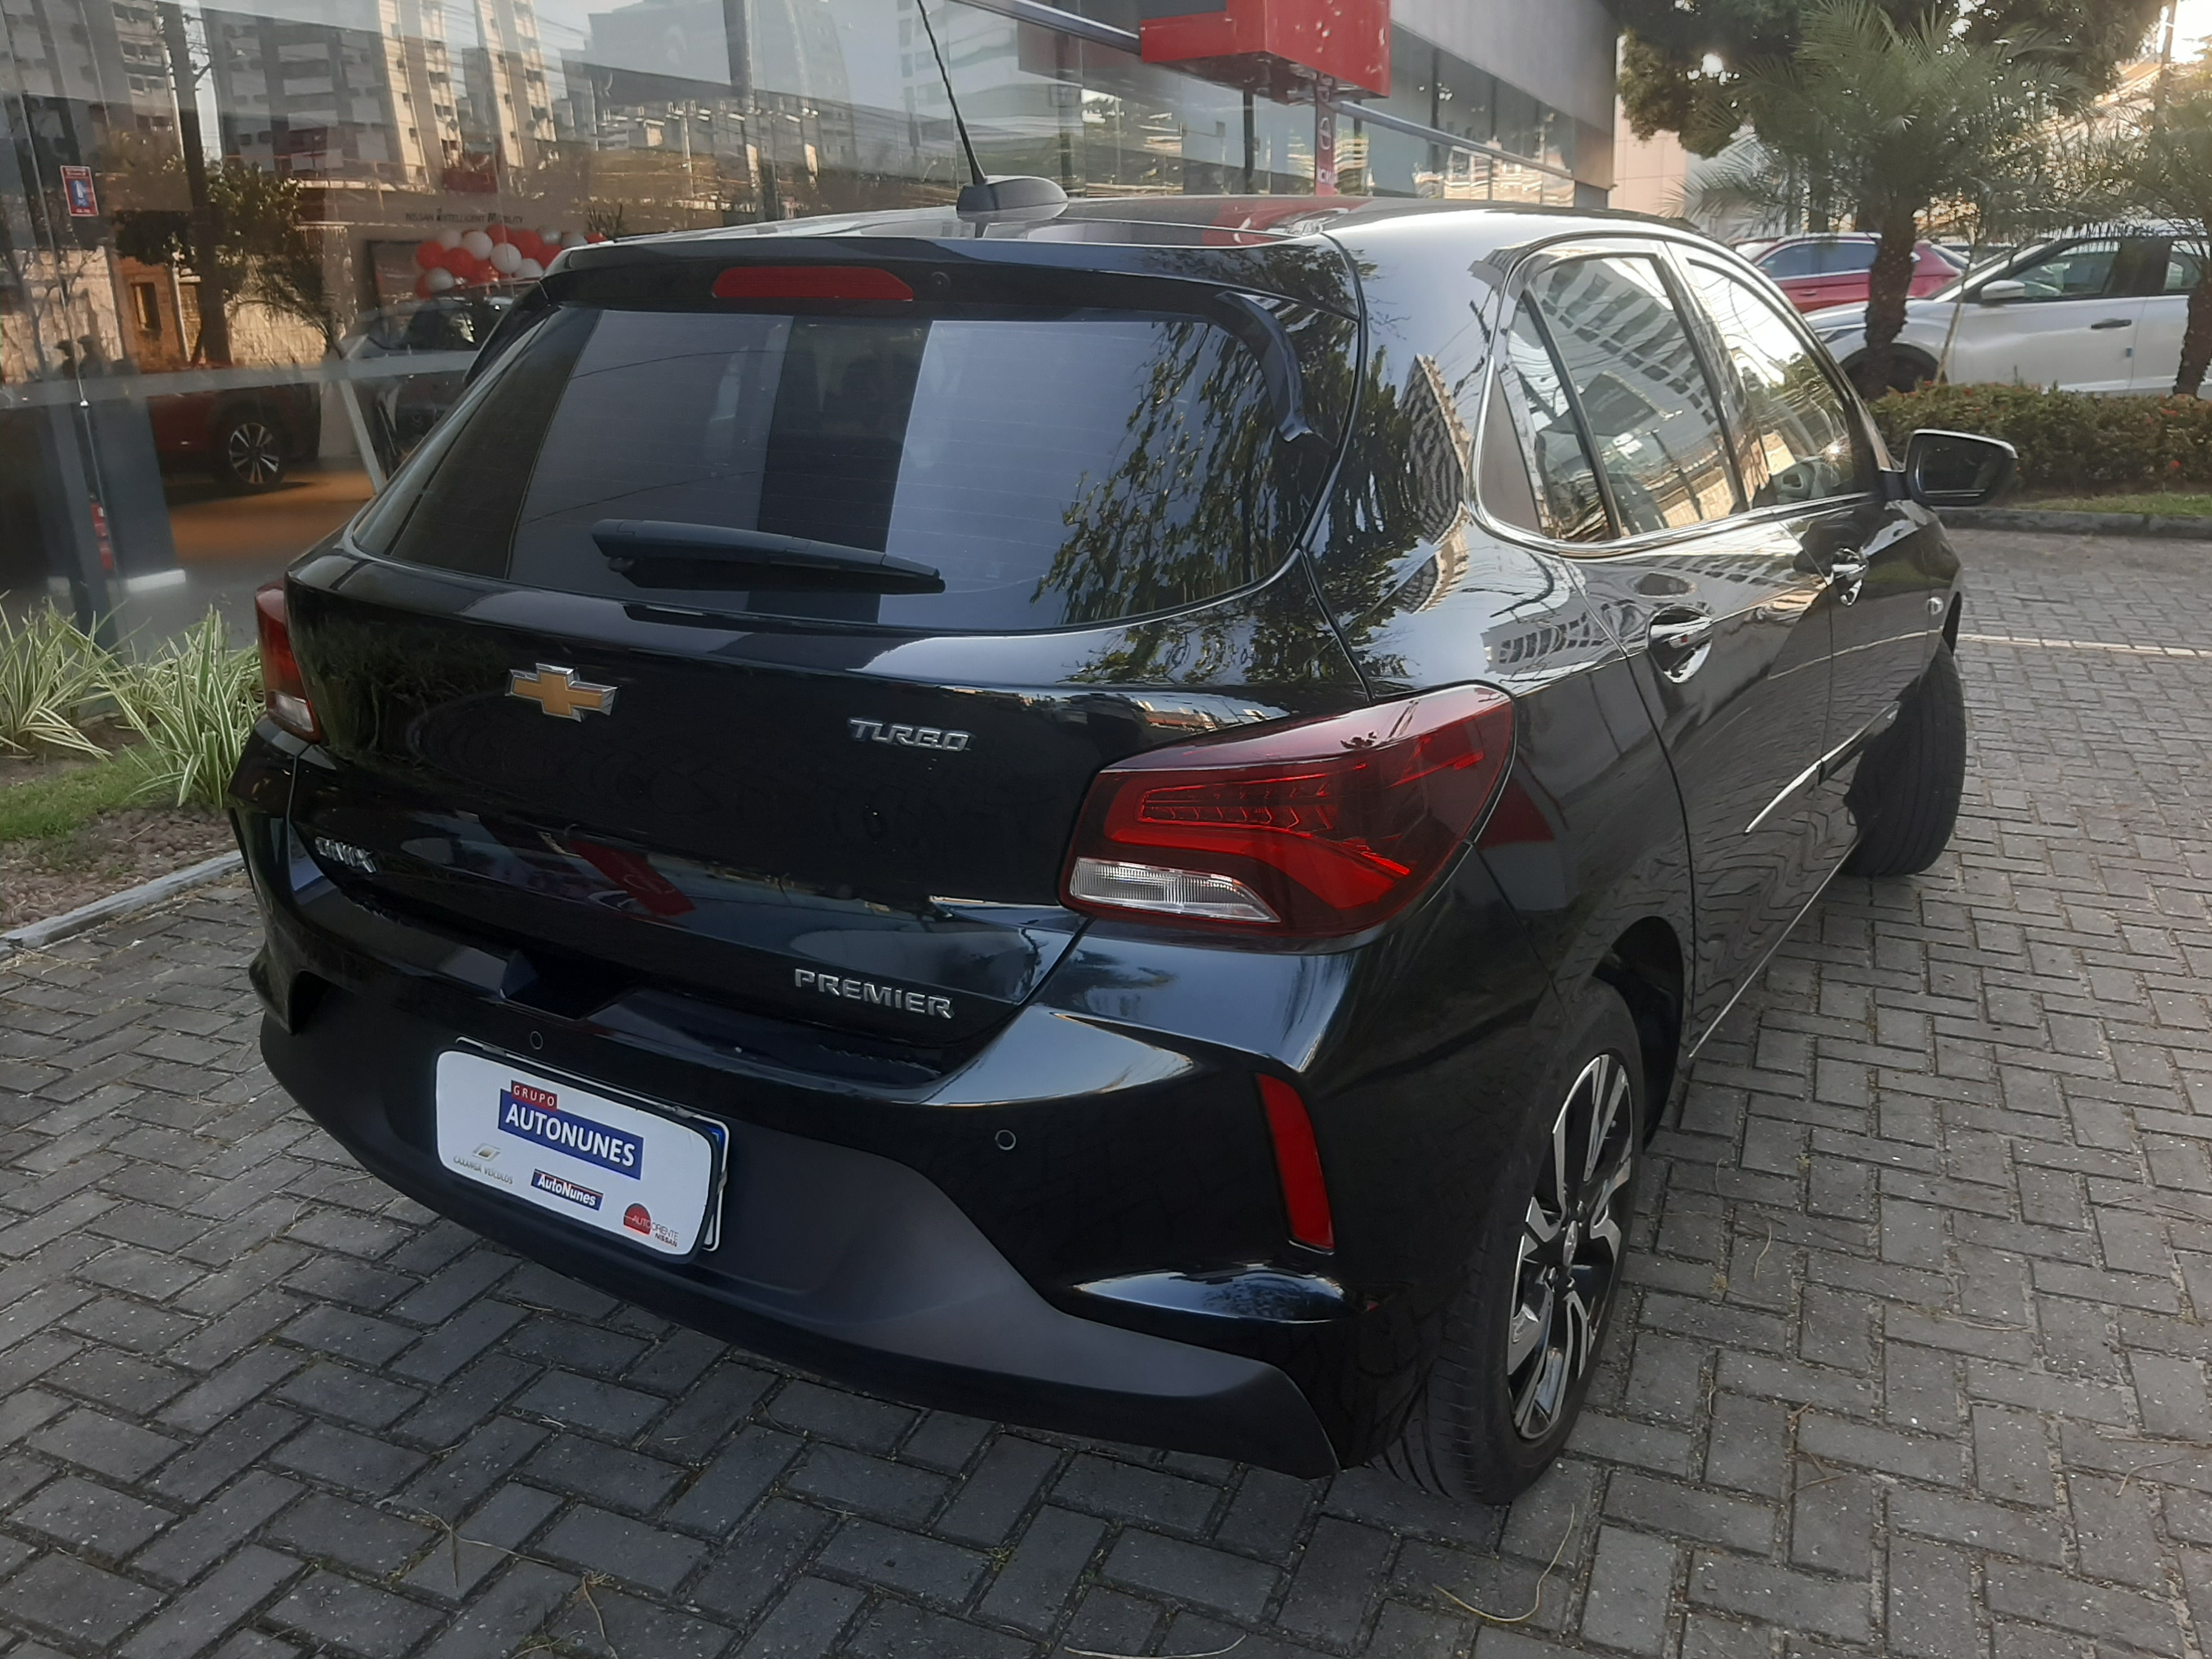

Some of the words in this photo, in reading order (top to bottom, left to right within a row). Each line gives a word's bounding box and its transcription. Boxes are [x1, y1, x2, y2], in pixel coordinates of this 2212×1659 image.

[850, 719, 969, 751] TURBO
[795, 968, 953, 1019] PREMIER
[513, 1085, 555, 1107] GRUPO
[505, 1103, 635, 1166] AUTONUNES
[538, 1173, 596, 1206] AutoNunes
[655, 1233, 678, 1247] NISSAN
